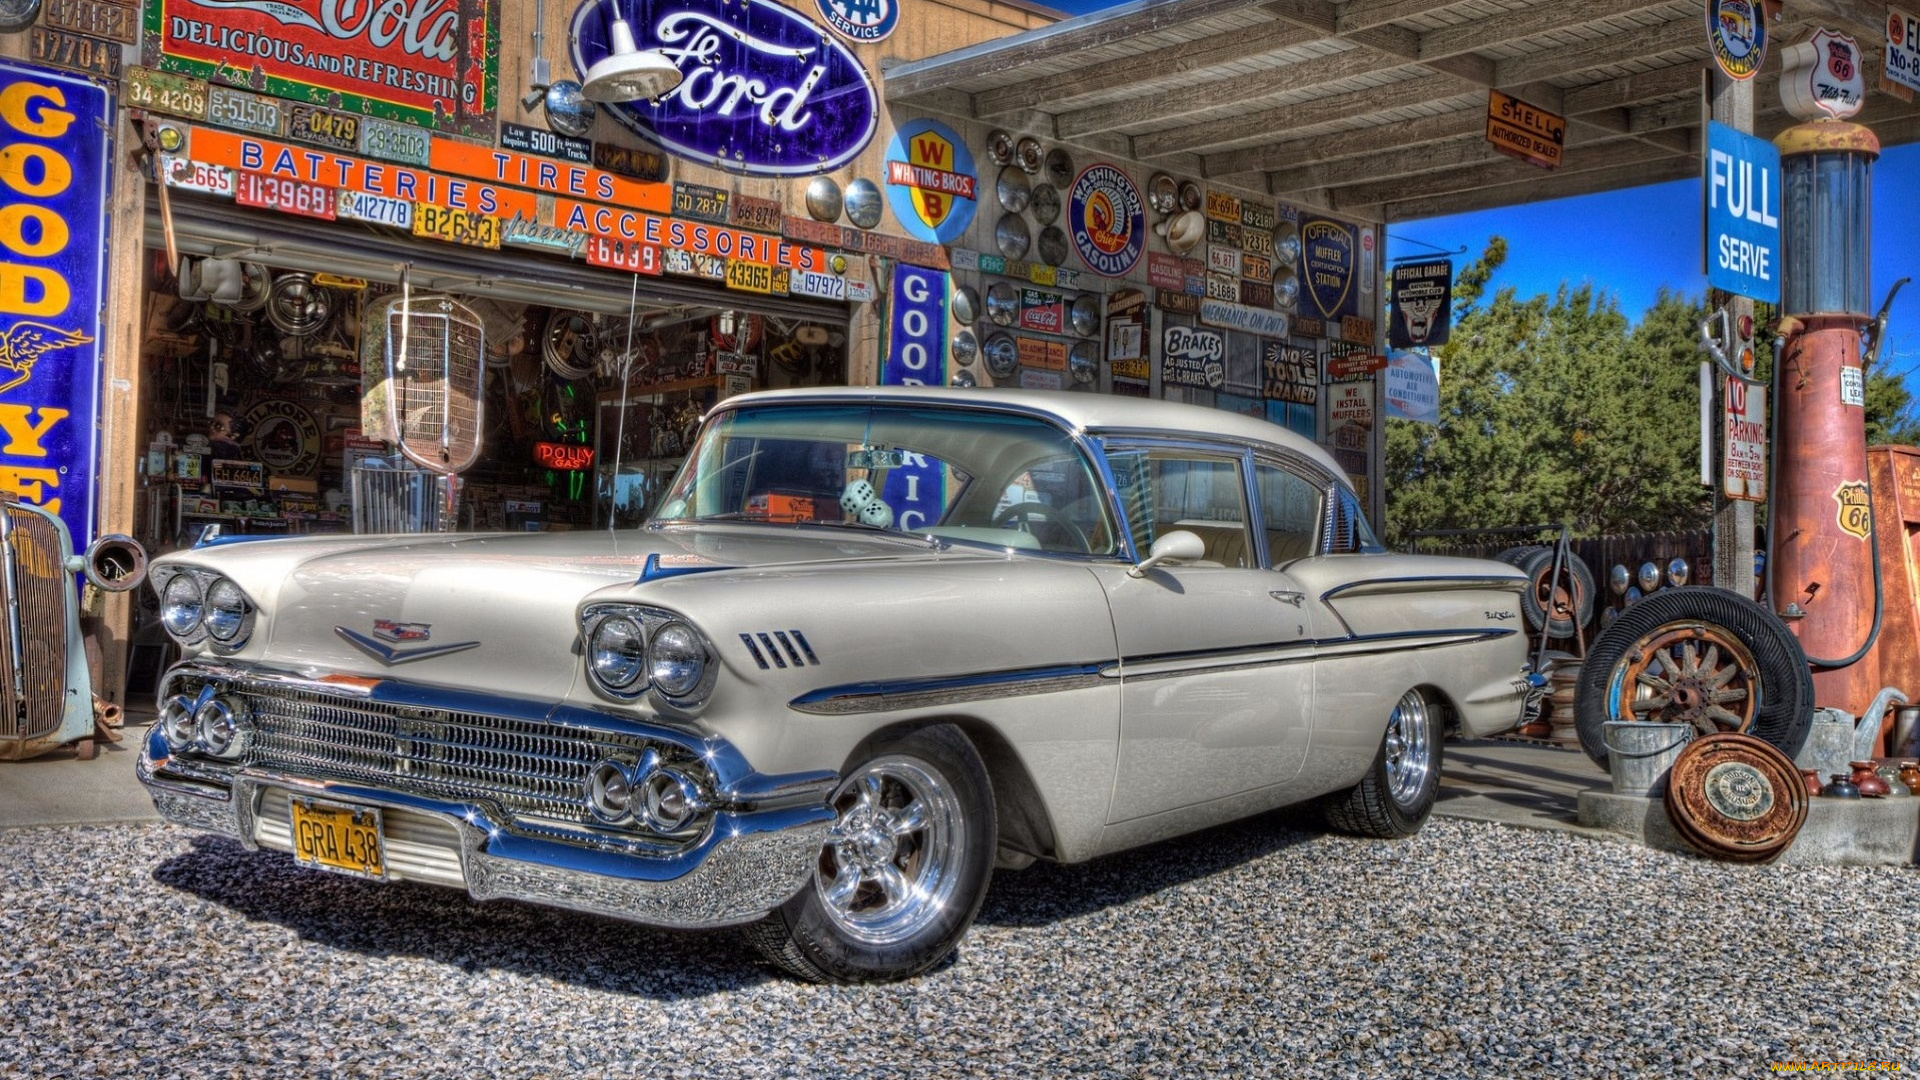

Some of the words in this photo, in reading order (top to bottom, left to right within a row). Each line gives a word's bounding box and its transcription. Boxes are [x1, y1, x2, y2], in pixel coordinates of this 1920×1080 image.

[828, 11, 880, 38] SERVICE
[171, 16, 304, 65] DELICIOUS
[305, 53, 341, 73] AND
[655, 12, 827, 132] Ford
[1834, 60, 1850, 77] 66
[1501, 102, 1554, 133] SHELL
[502, 134, 529, 148] Requires
[531, 131, 556, 153] 500
[509, 126, 525, 136] Law
[567, 149, 587, 160] Trucks
[918, 138, 945, 165] W
[1533, 140, 1558, 157] DEALER
[241, 140, 497, 214] BATTERIES
[492, 152, 615, 200] TIRES
[892, 162, 940, 188] WHITING
[942, 173, 972, 193] BROS.
[1711, 148, 1778, 229] FULL
[1073, 168, 1142, 216] WASHINGTON
[923, 192, 943, 218] B
[503, 210, 588, 259] Liberty
[566, 204, 815, 269] ACCESSORIES
[1095, 230, 1126, 251] Chief
[1308, 224, 1349, 249] OFFICIAL
[1076, 230, 1138, 273] GASOLINE
[1315, 245, 1342, 263] MUFFLER
[1719, 233, 1770, 281] SERVE
[729, 263, 769, 290] 43365
[1311, 261, 1345, 273] CERTIFICATION
[1396, 268, 1423, 280] OFFICIAL
[804, 273, 843, 298] 197972
[1315, 272, 1341, 288] STATION
[1201, 302, 1248, 327] MECHANIC
[1250, 315, 1263, 330] ON
[1264, 316, 1287, 333] DUTY
[1168, 330, 1221, 356] BRAKES
[1280, 347, 1301, 362] NO
[1165, 356, 1206, 370] ADJUSTED!
[1263, 360, 1316, 386] TOOLS
[1263, 381, 1316, 404] LOANED
[1345, 387, 1358, 397] WE
[1406, 382, 1418, 392] AIR
[1331, 409, 1371, 420] MUFFLERS
[1336, 399, 1367, 409] INSTALL
[1728, 418, 1763, 445] PARKING
[540, 444, 594, 466] POLLY
[554, 459, 580, 469] GAS
[1848, 507, 1869, 532] 66
[300, 820, 339, 861] GRA
[345, 827, 379, 867] 438
